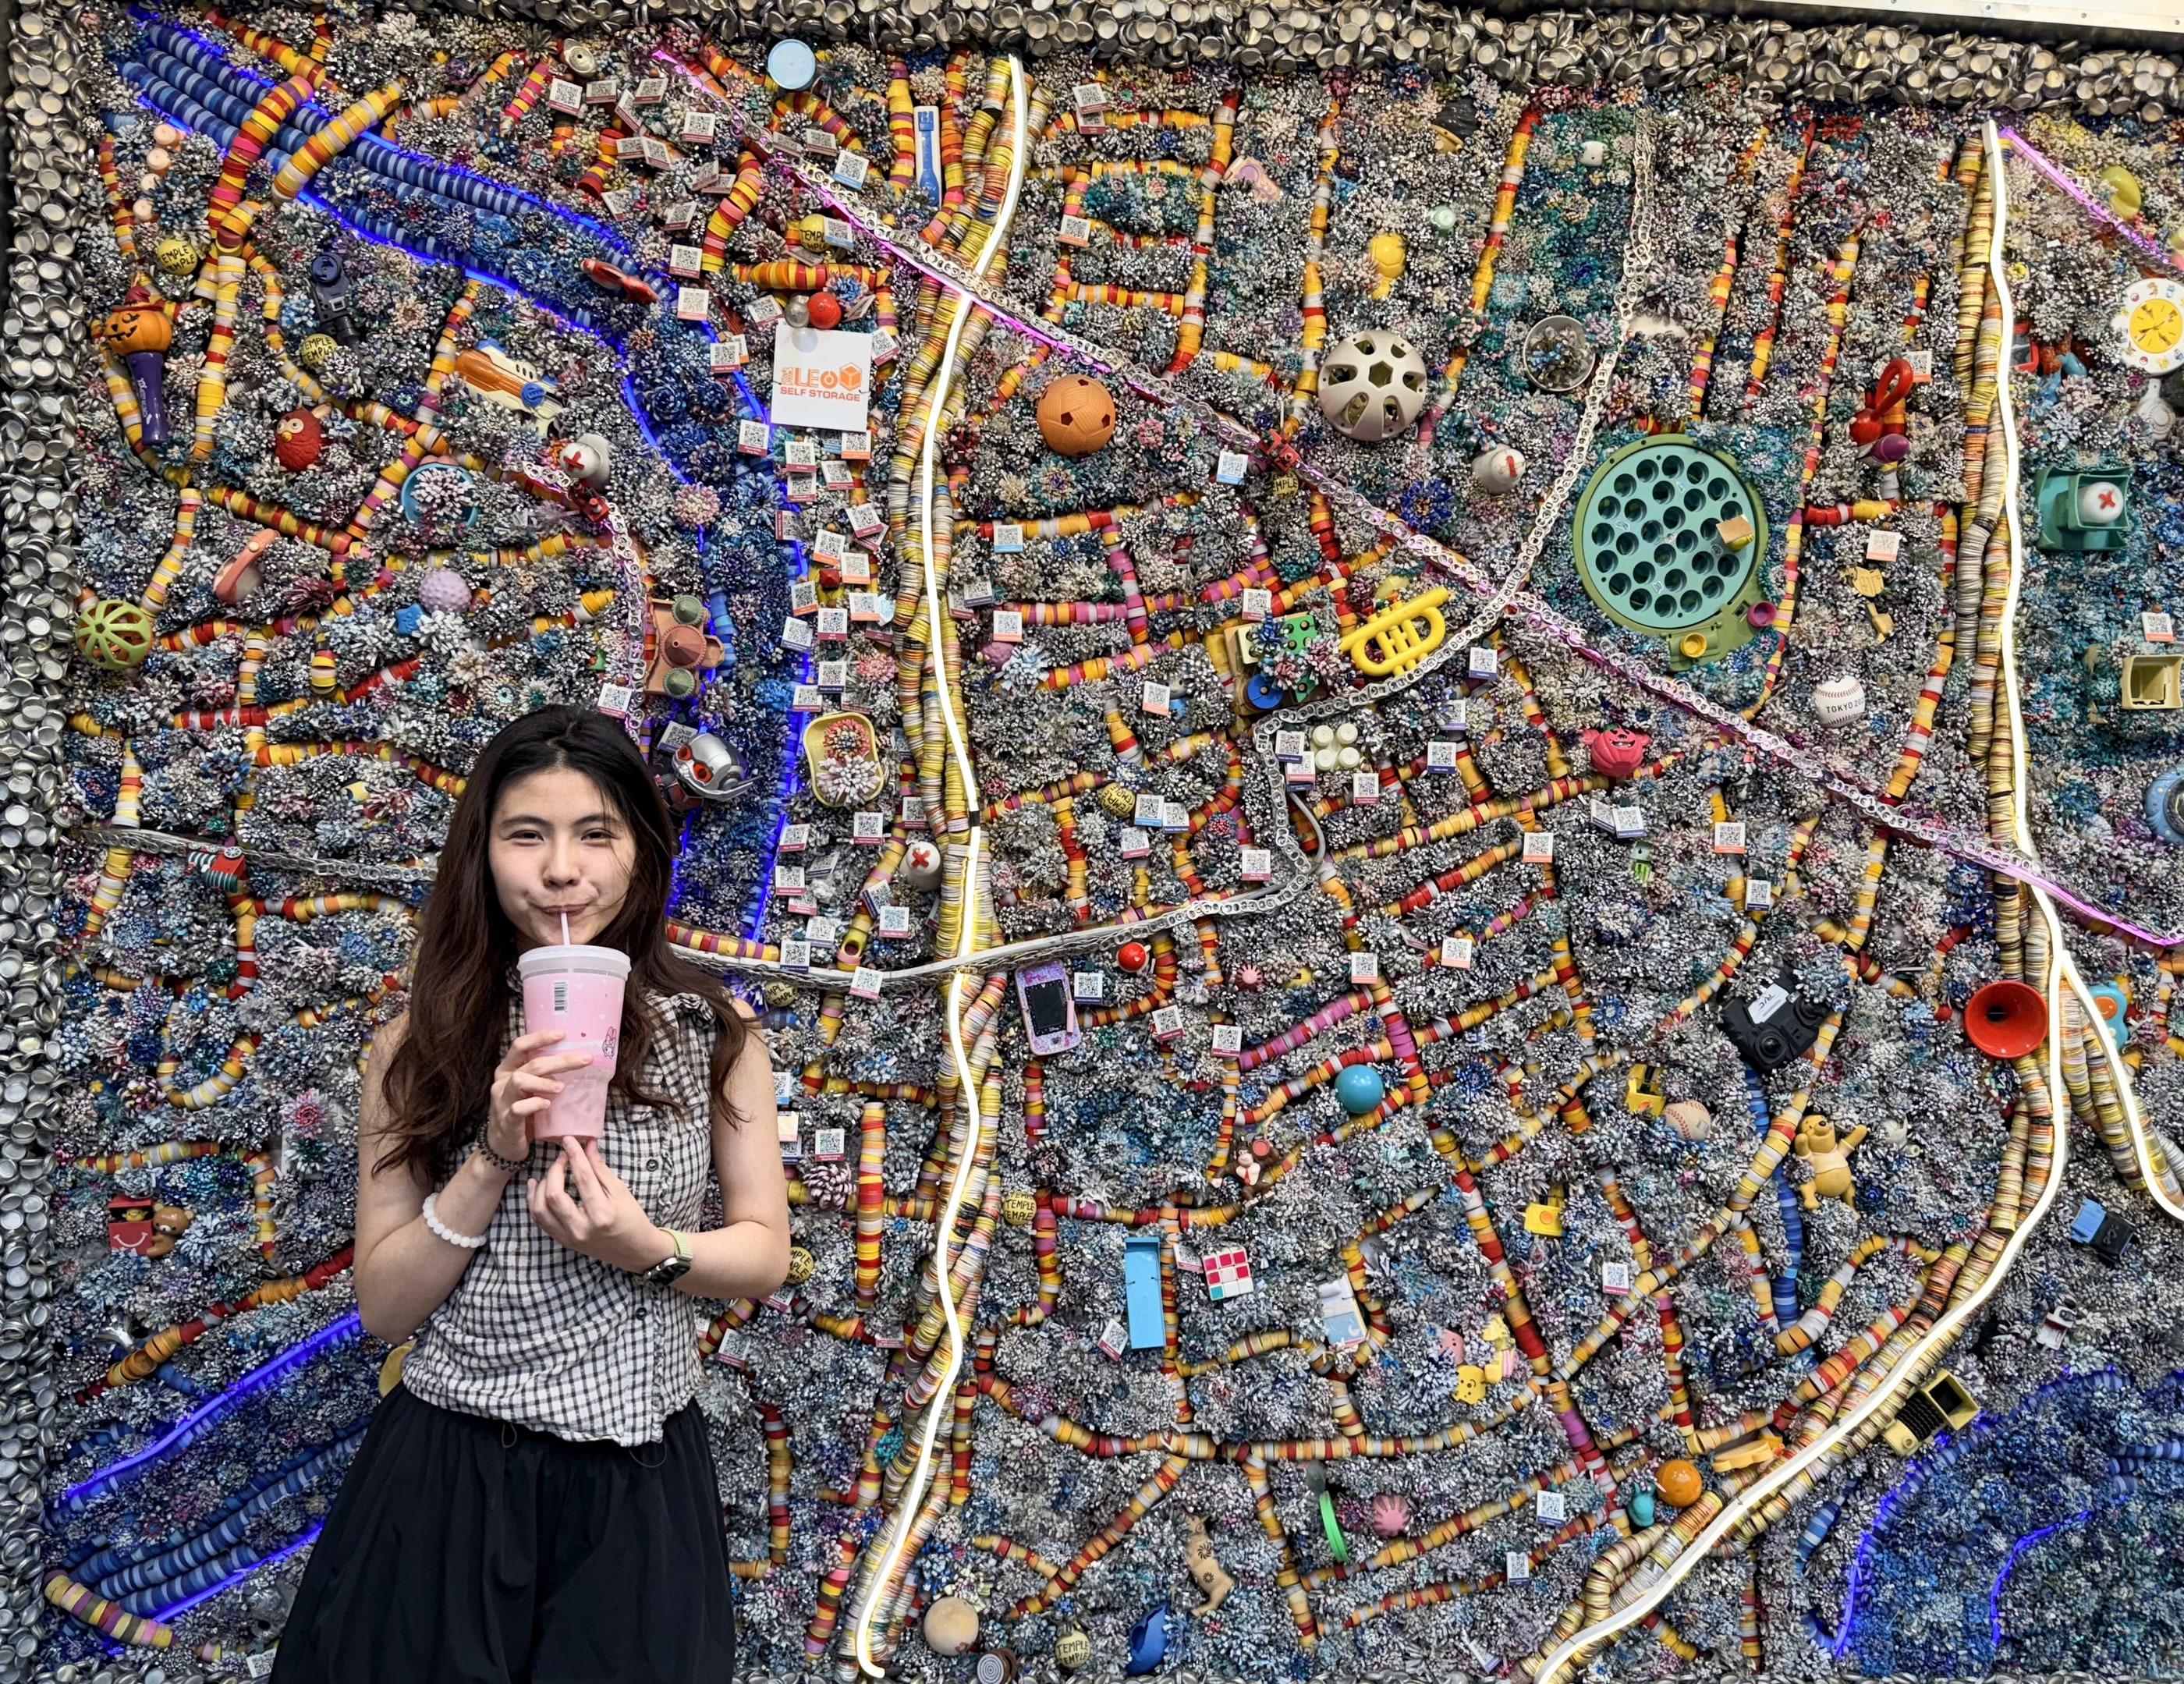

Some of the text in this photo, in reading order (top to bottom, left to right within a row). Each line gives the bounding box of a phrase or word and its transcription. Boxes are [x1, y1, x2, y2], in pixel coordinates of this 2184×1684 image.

[799, 229, 825, 243] TEMPL
[161, 245, 190, 264] EMPLE
[303, 346, 332, 362] EMPL
[780, 387, 861, 402] SELF STORAGE
[1826, 702, 1853, 714] TOKYO
[1005, 1199, 1034, 1211] TEMPLE
[1056, 1640, 1089, 1656] TEMPLE
